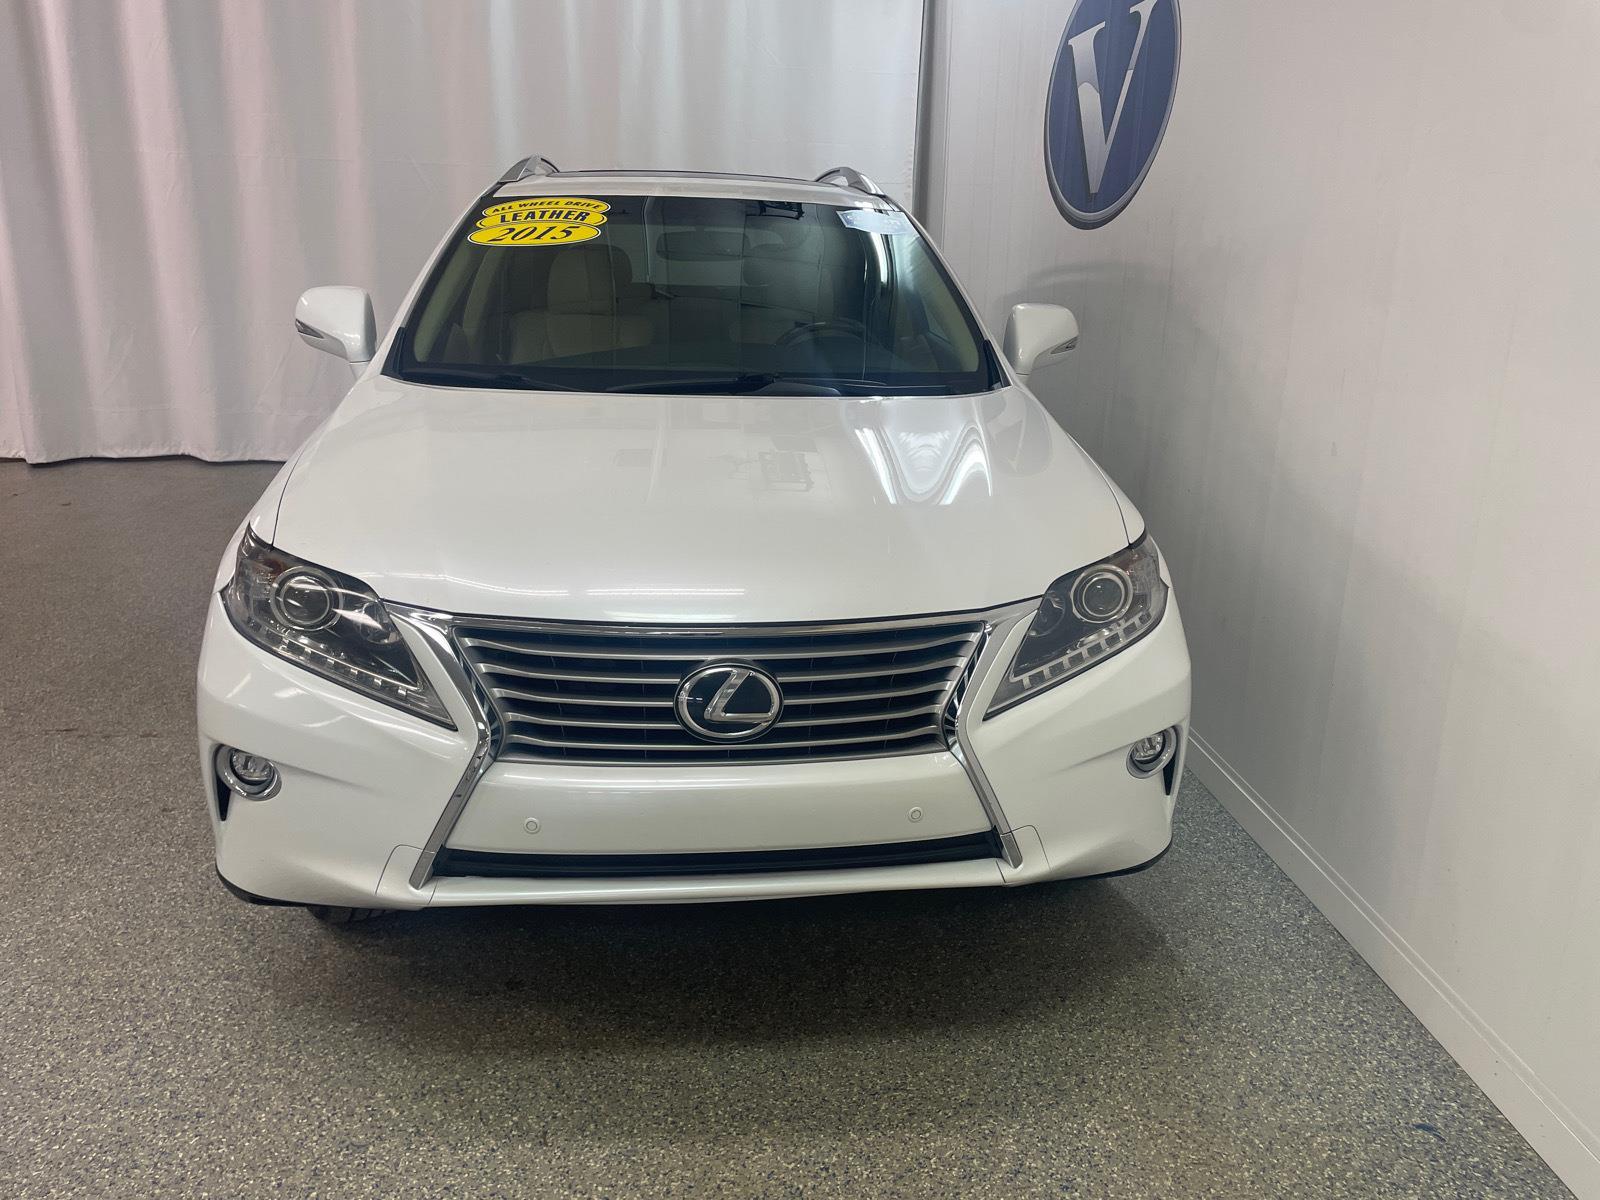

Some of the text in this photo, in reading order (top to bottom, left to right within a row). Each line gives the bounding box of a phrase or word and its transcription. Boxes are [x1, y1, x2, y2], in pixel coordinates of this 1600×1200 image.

[1068, 0, 1157, 193] V
[492, 200, 603, 214] ALL WHEEL DRIVE
[500, 209, 590, 223] LEATHER
[487, 225, 580, 242] 2015
